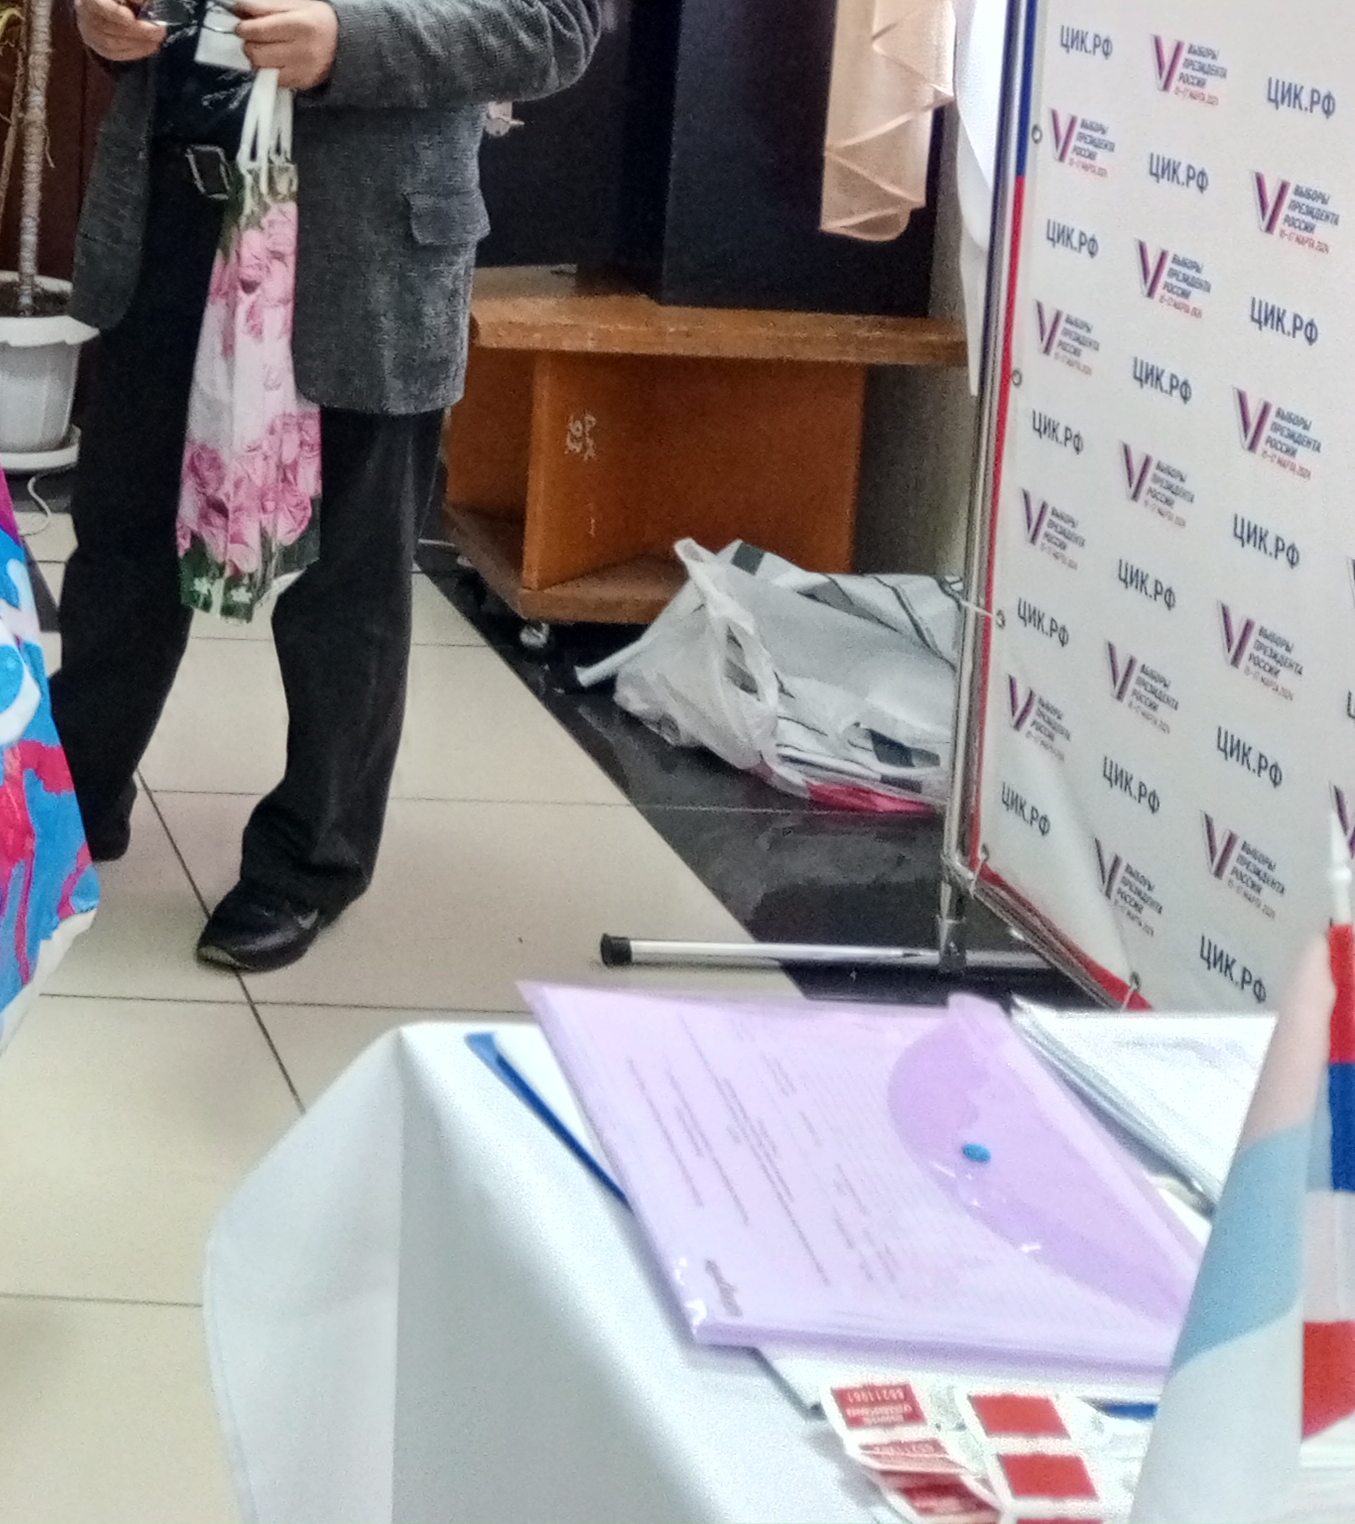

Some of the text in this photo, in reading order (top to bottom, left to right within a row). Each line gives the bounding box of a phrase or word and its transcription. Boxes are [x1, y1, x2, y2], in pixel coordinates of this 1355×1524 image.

[1060, 25, 1114, 60] ЦИК.РФ
[1267, 76, 1336, 120] ЦИК.РФ
[1149, 152, 1209, 194] ЦИК.РФ
[1046, 219, 1099, 259] ЦИК.РФ
[1250, 296, 1319, 346] ЦИК.РФ
[1133, 356, 1193, 405] ЦИК.РФ
[1032, 409, 1084, 456] ЦИК.РФ
[1233, 513, 1301, 570] ЦИК.РФ
[1118, 558, 1176, 611] ЦИК.РФ
[1018, 597, 1069, 648] ЦИК.РФ
[1217, 726, 1283, 789] ЦИК.РФ
[1001, 781, 1051, 836] ЦИК.РФ
[1102, 756, 1160, 814] ЦИК.РФ
[1199, 933, 1267, 1004] ЦИК.РФ
